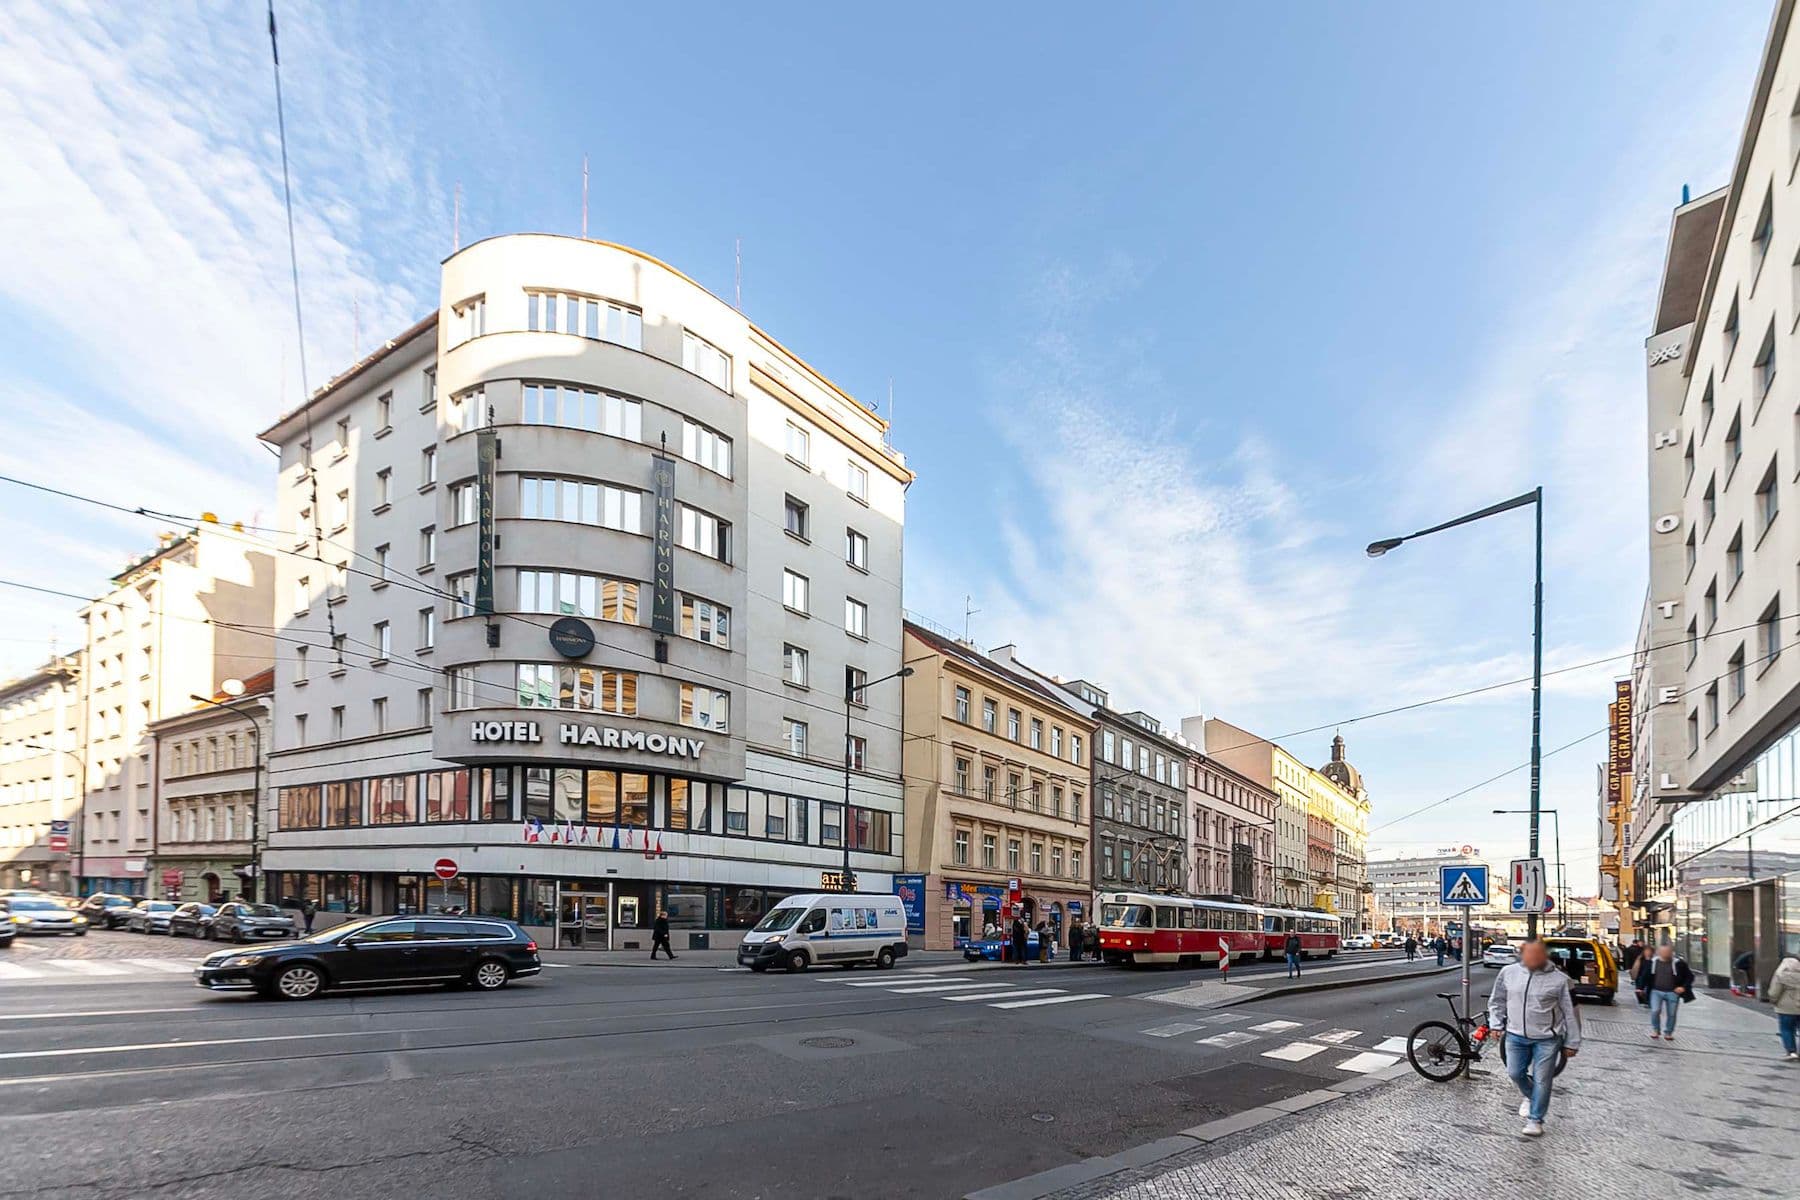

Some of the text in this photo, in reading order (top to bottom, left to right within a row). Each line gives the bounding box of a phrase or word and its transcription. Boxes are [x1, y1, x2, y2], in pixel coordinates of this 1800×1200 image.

[480, 474, 492, 586] HARMONY
[657, 497, 670, 605] HARMONY
[1654, 428, 1680, 790] HOTEL
[471, 721, 705, 759] HOTEL HARMONY
[1618, 696, 1631, 759] GRANDIOR
